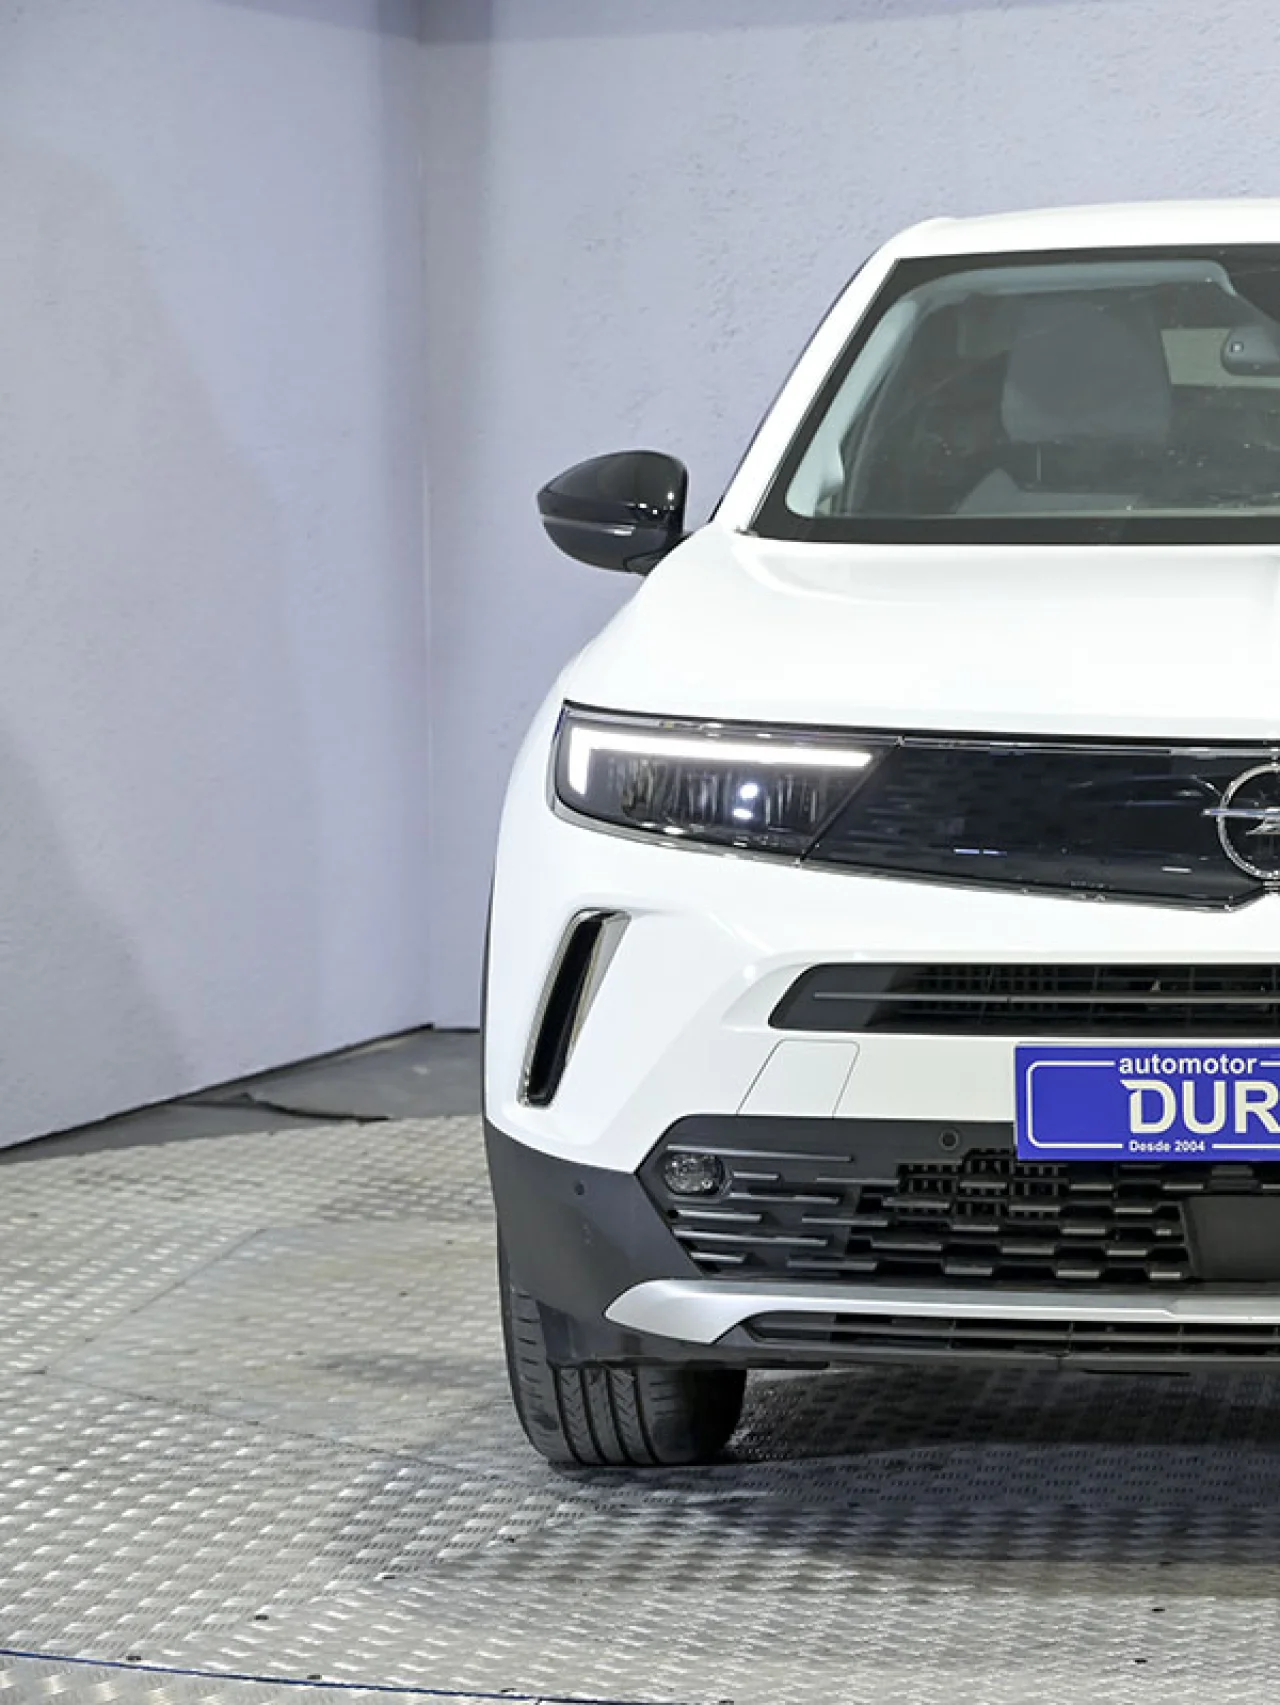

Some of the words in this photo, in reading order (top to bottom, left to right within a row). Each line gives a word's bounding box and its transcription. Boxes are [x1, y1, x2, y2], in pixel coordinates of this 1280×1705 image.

[1118, 1054, 1258, 1075] automotor
[1129, 1140, 1171, 1153] Desde
[1174, 1140, 1206, 1153] 2004
